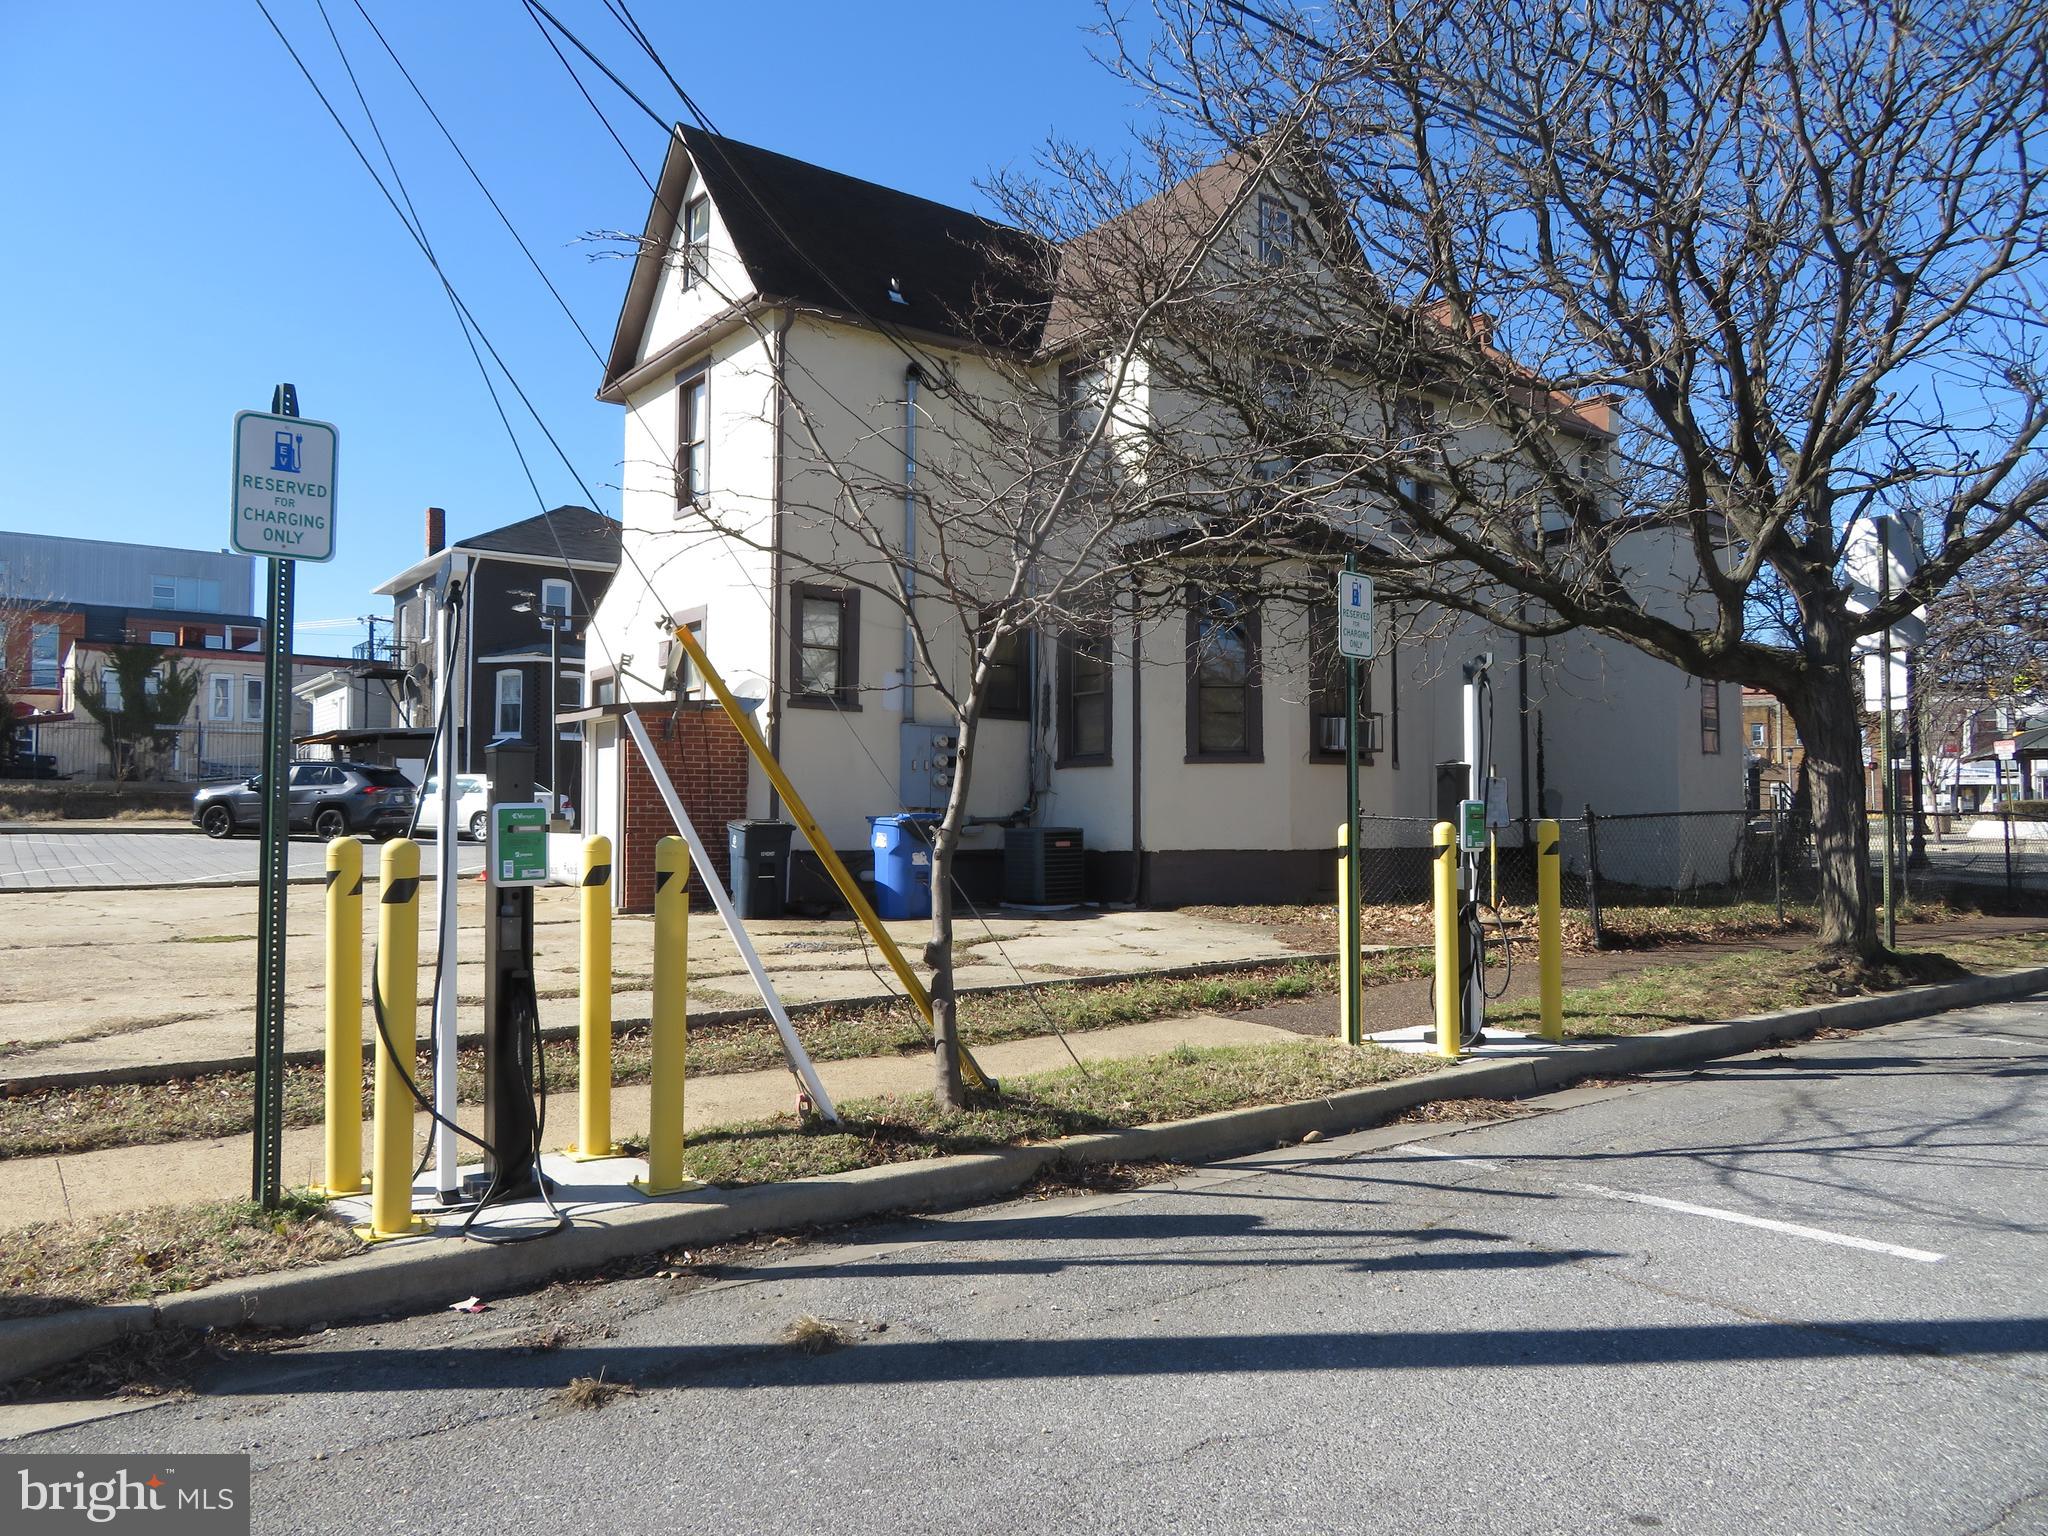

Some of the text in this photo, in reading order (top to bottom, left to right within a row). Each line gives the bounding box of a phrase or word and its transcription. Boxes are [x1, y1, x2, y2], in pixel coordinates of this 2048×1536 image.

[243, 475, 327, 498] RESERVED
[274, 496, 295, 508] FOR
[243, 507, 325, 530] CHARGING
[263, 527, 304, 545] ONLY
[1343, 608, 1370, 621] RESERVED
[1343, 627, 1370, 640] CHARGING
[1349, 639, 1363, 649] ONLY
